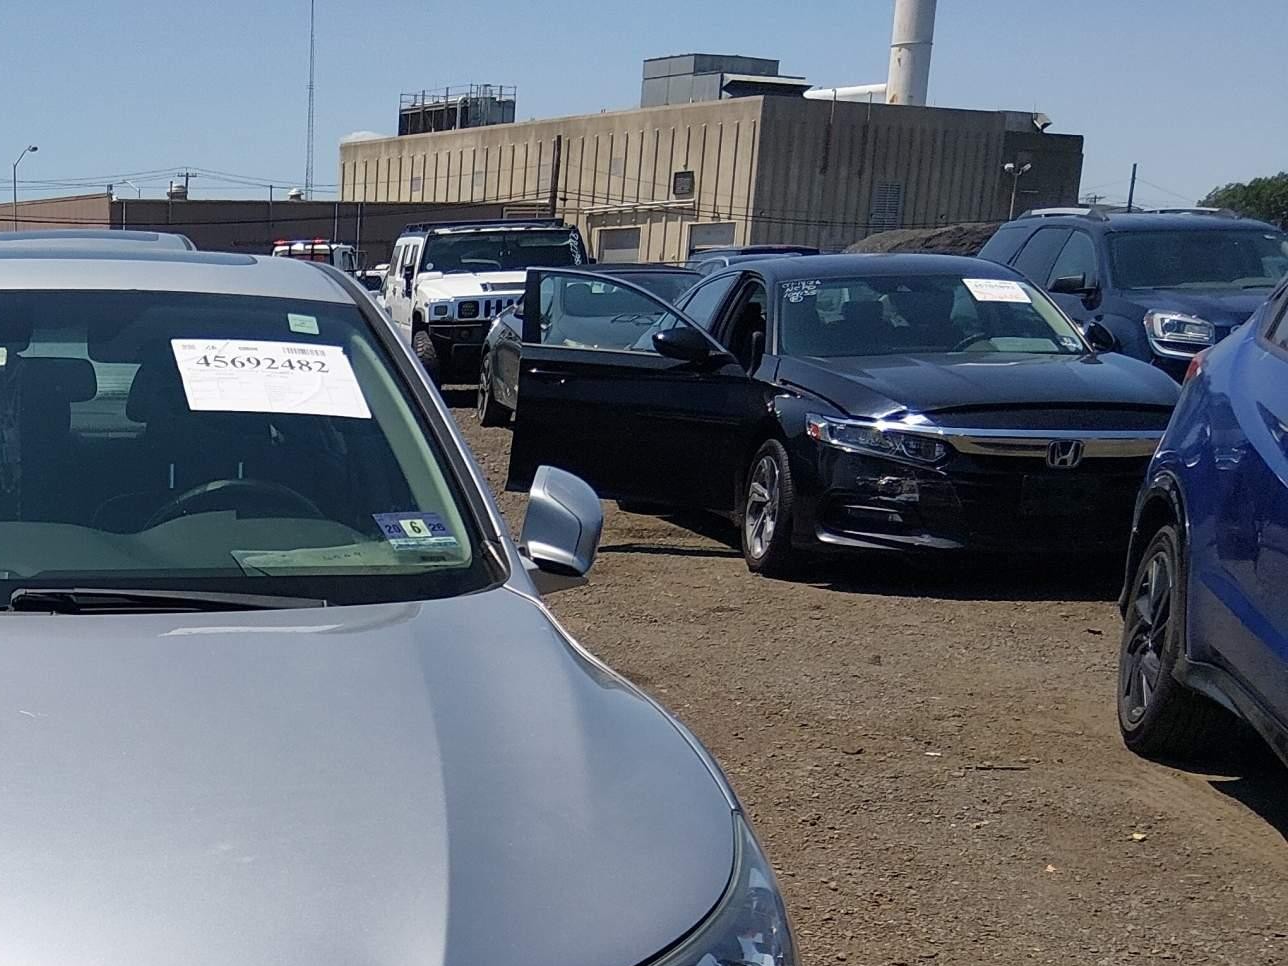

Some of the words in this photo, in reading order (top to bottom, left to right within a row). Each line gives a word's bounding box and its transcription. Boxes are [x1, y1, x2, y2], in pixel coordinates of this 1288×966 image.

[196, 354, 329, 373] 45692482
[385, 524, 401, 534] 20
[409, 521, 421, 534] 6
